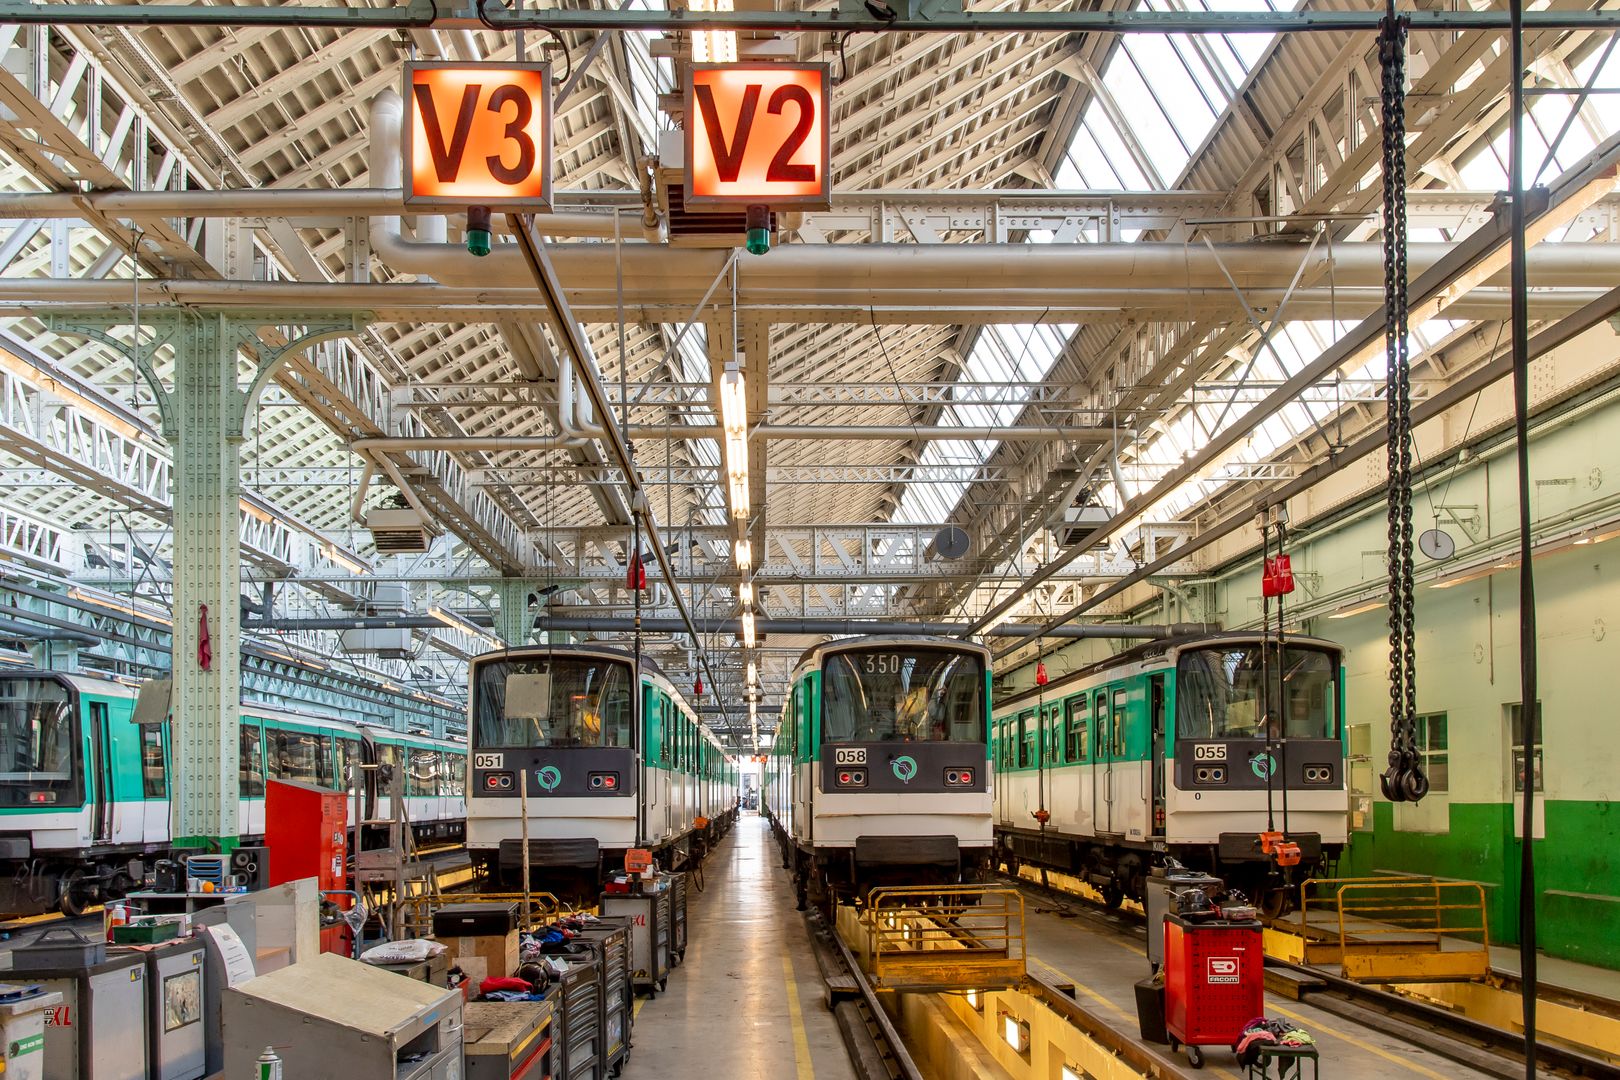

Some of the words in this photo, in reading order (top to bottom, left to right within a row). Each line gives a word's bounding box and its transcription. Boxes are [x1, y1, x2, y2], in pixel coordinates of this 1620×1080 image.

[413, 84, 535, 185] V3
[694, 84, 816, 183] V2
[866, 654, 899, 673] 350
[476, 755, 501, 767] 051
[837, 750, 865, 763] 058
[1195, 746, 1226, 759] 055
[50, 1006, 72, 1026] XL
